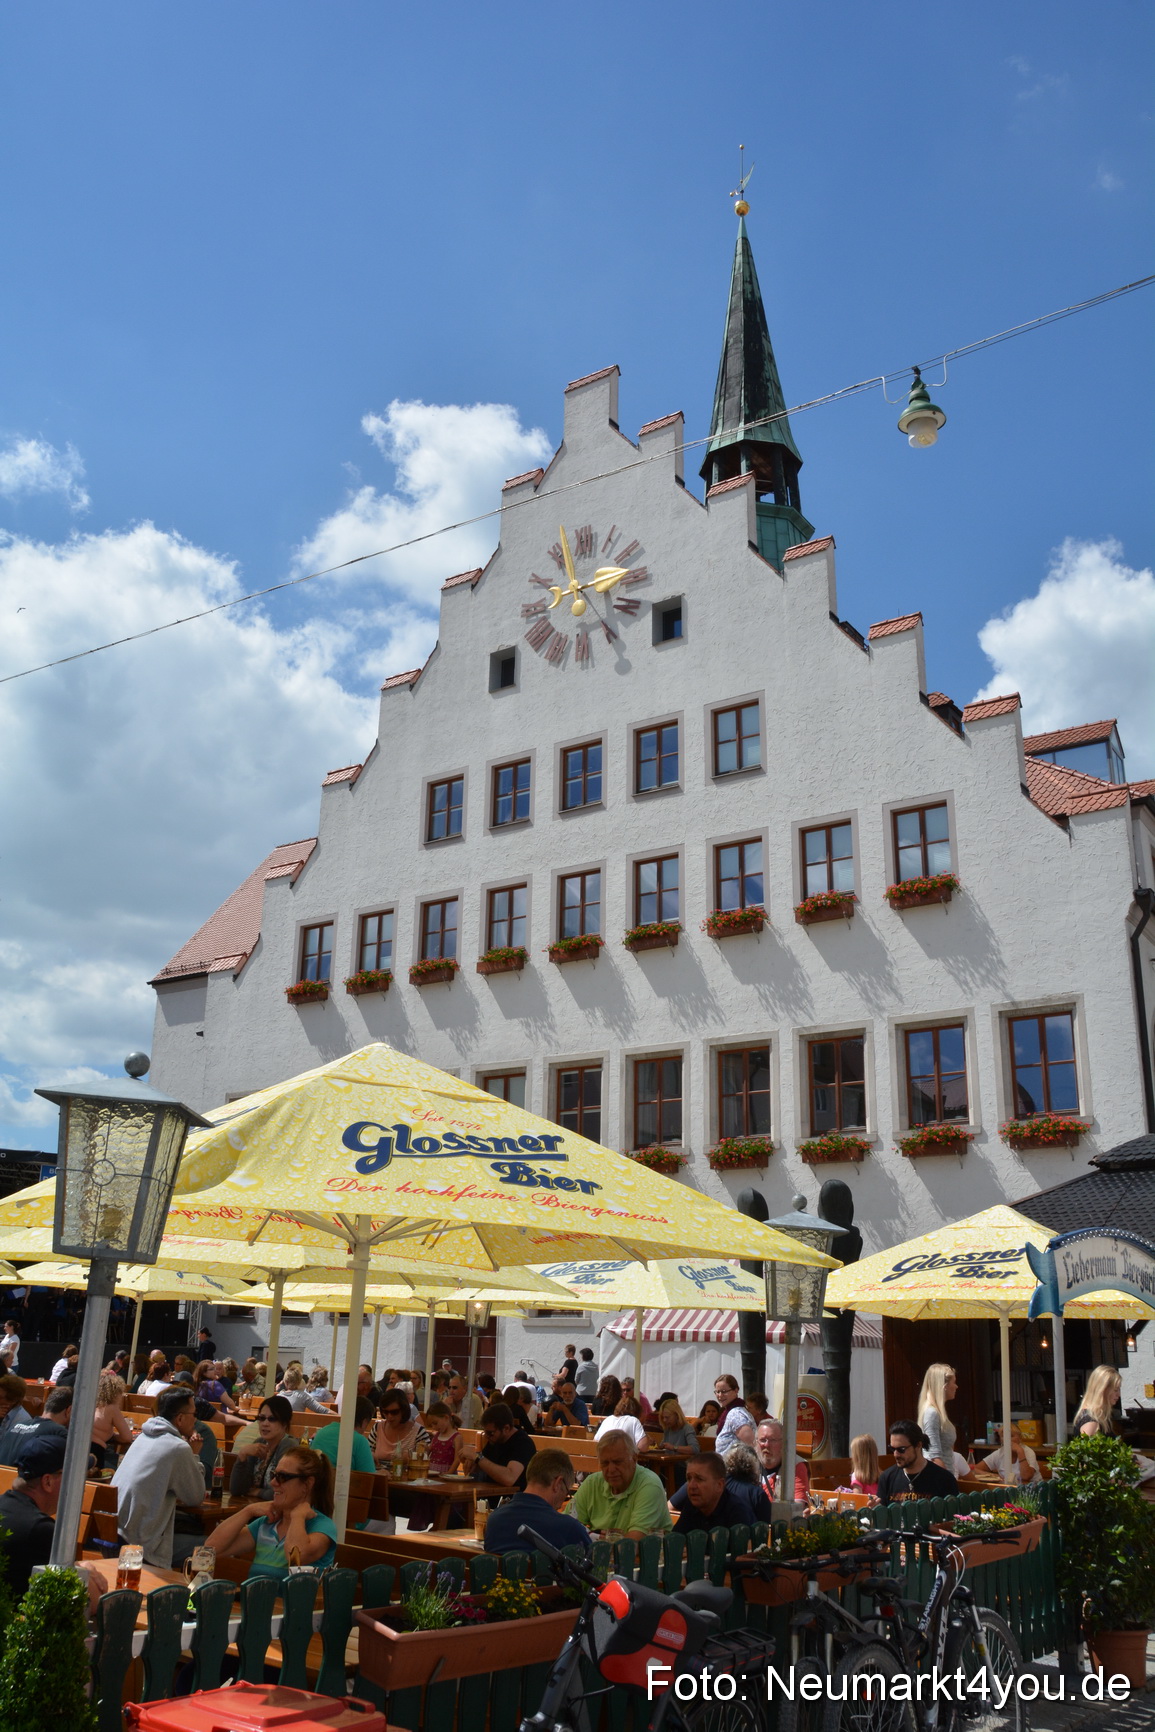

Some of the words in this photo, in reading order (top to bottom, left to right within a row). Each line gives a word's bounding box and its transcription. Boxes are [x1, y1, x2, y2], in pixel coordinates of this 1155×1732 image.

[411, 1108, 444, 1122] Seit
[342, 1120, 567, 1175] Glossner
[490, 1161, 603, 1196] Bier
[323, 1177, 388, 1192] Der
[395, 1180, 520, 1202] hochfeine
[531, 1192, 669, 1224] Biergenuss
[540, 1260, 633, 1278] Glossner
[678, 1264, 737, 1290] Glossner
[882, 1246, 1026, 1283] Glossner
[950, 1264, 1019, 1280] Bier
[567, 1273, 615, 1286] Bier
[725, 1278, 757, 1294] Bier
[918, 1579, 942, 1632] STARLIGHT
